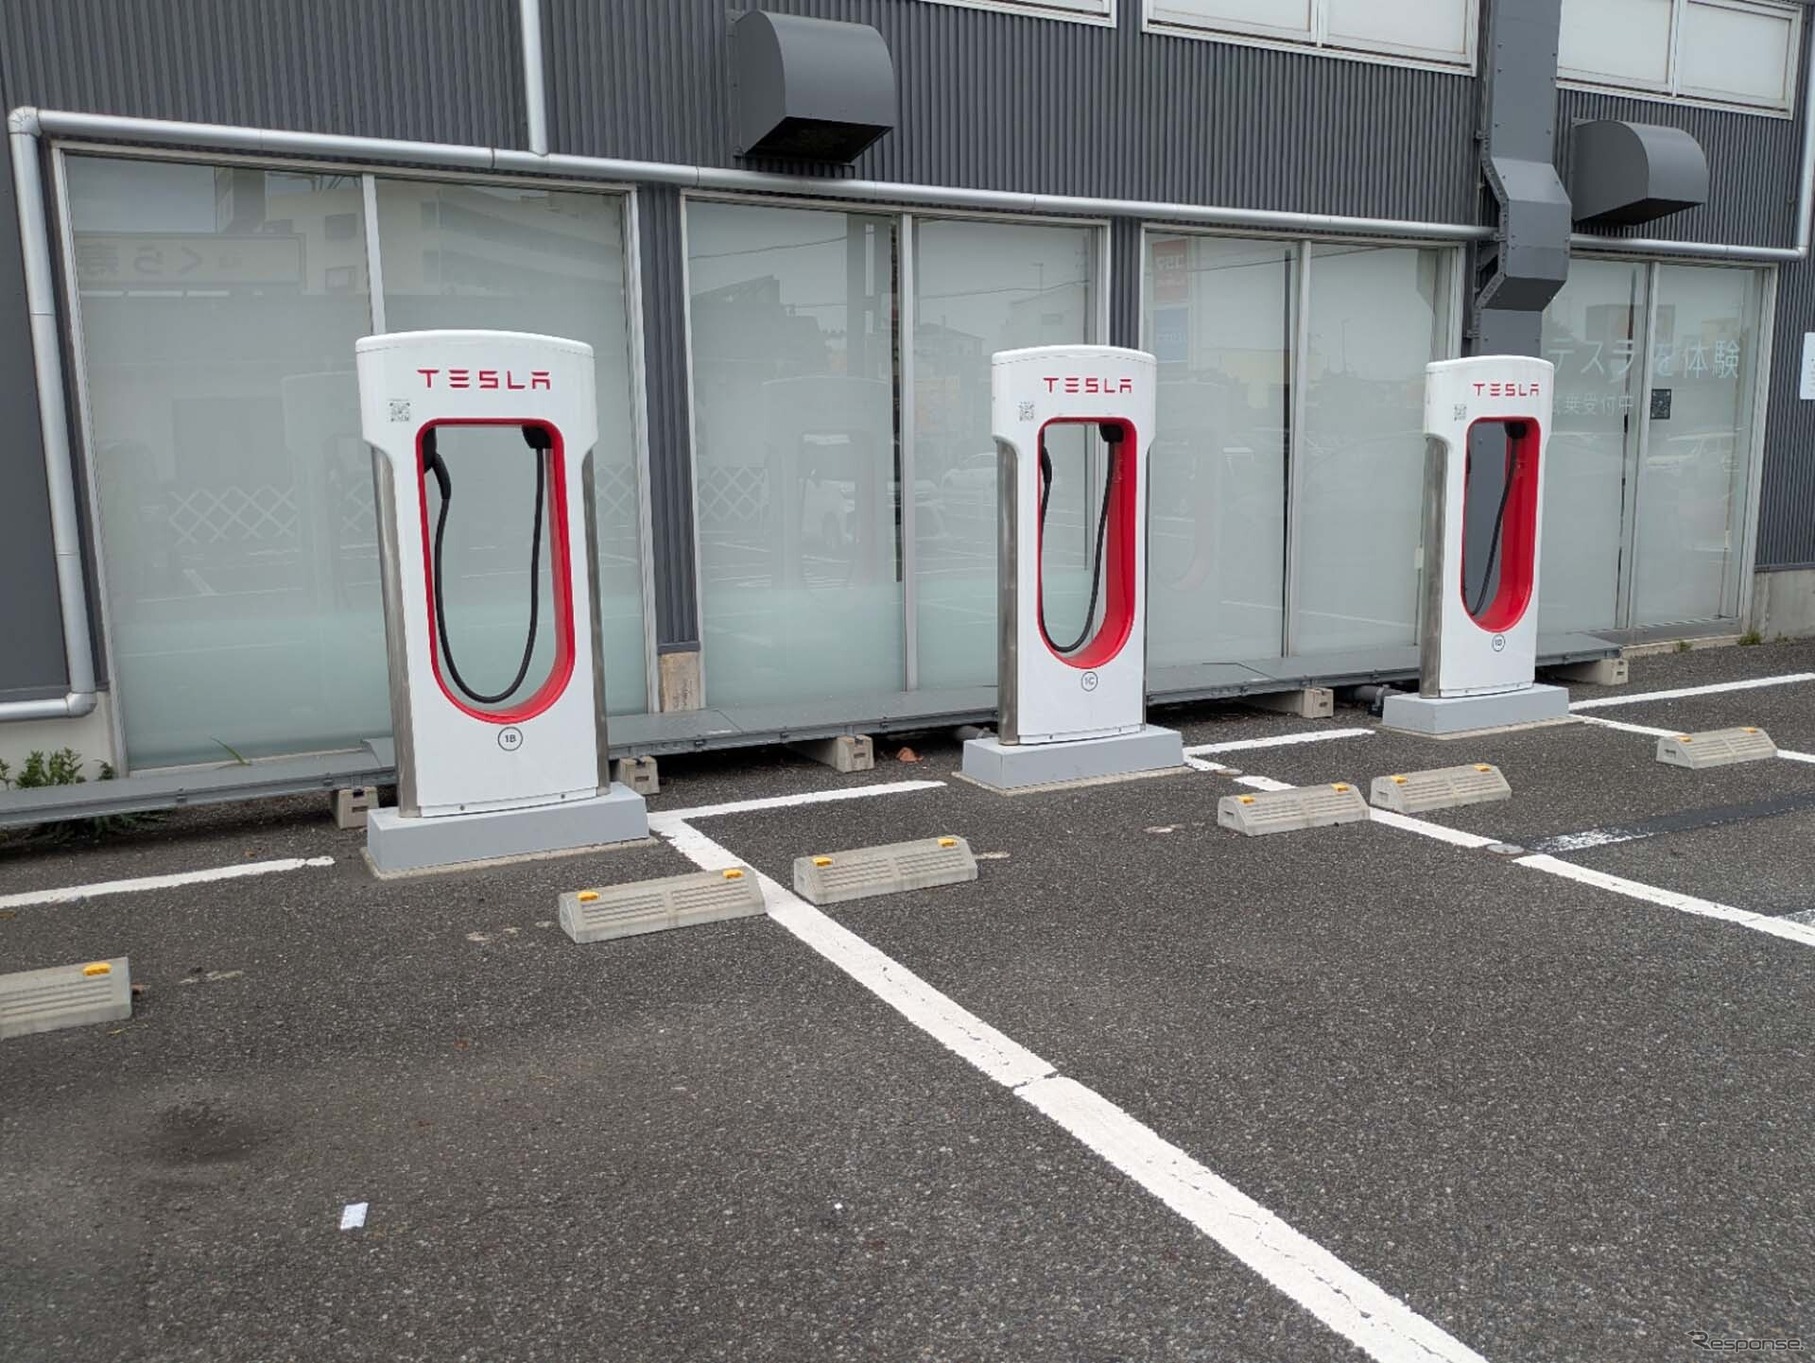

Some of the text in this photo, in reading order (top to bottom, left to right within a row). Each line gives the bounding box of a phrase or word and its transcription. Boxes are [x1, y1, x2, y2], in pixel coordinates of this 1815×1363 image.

[416, 368, 552, 390] TESLA
[1042, 377, 1133, 394] TESLA
[1473, 383, 1540, 397] TESLA
[504, 734, 517, 743] 1B
